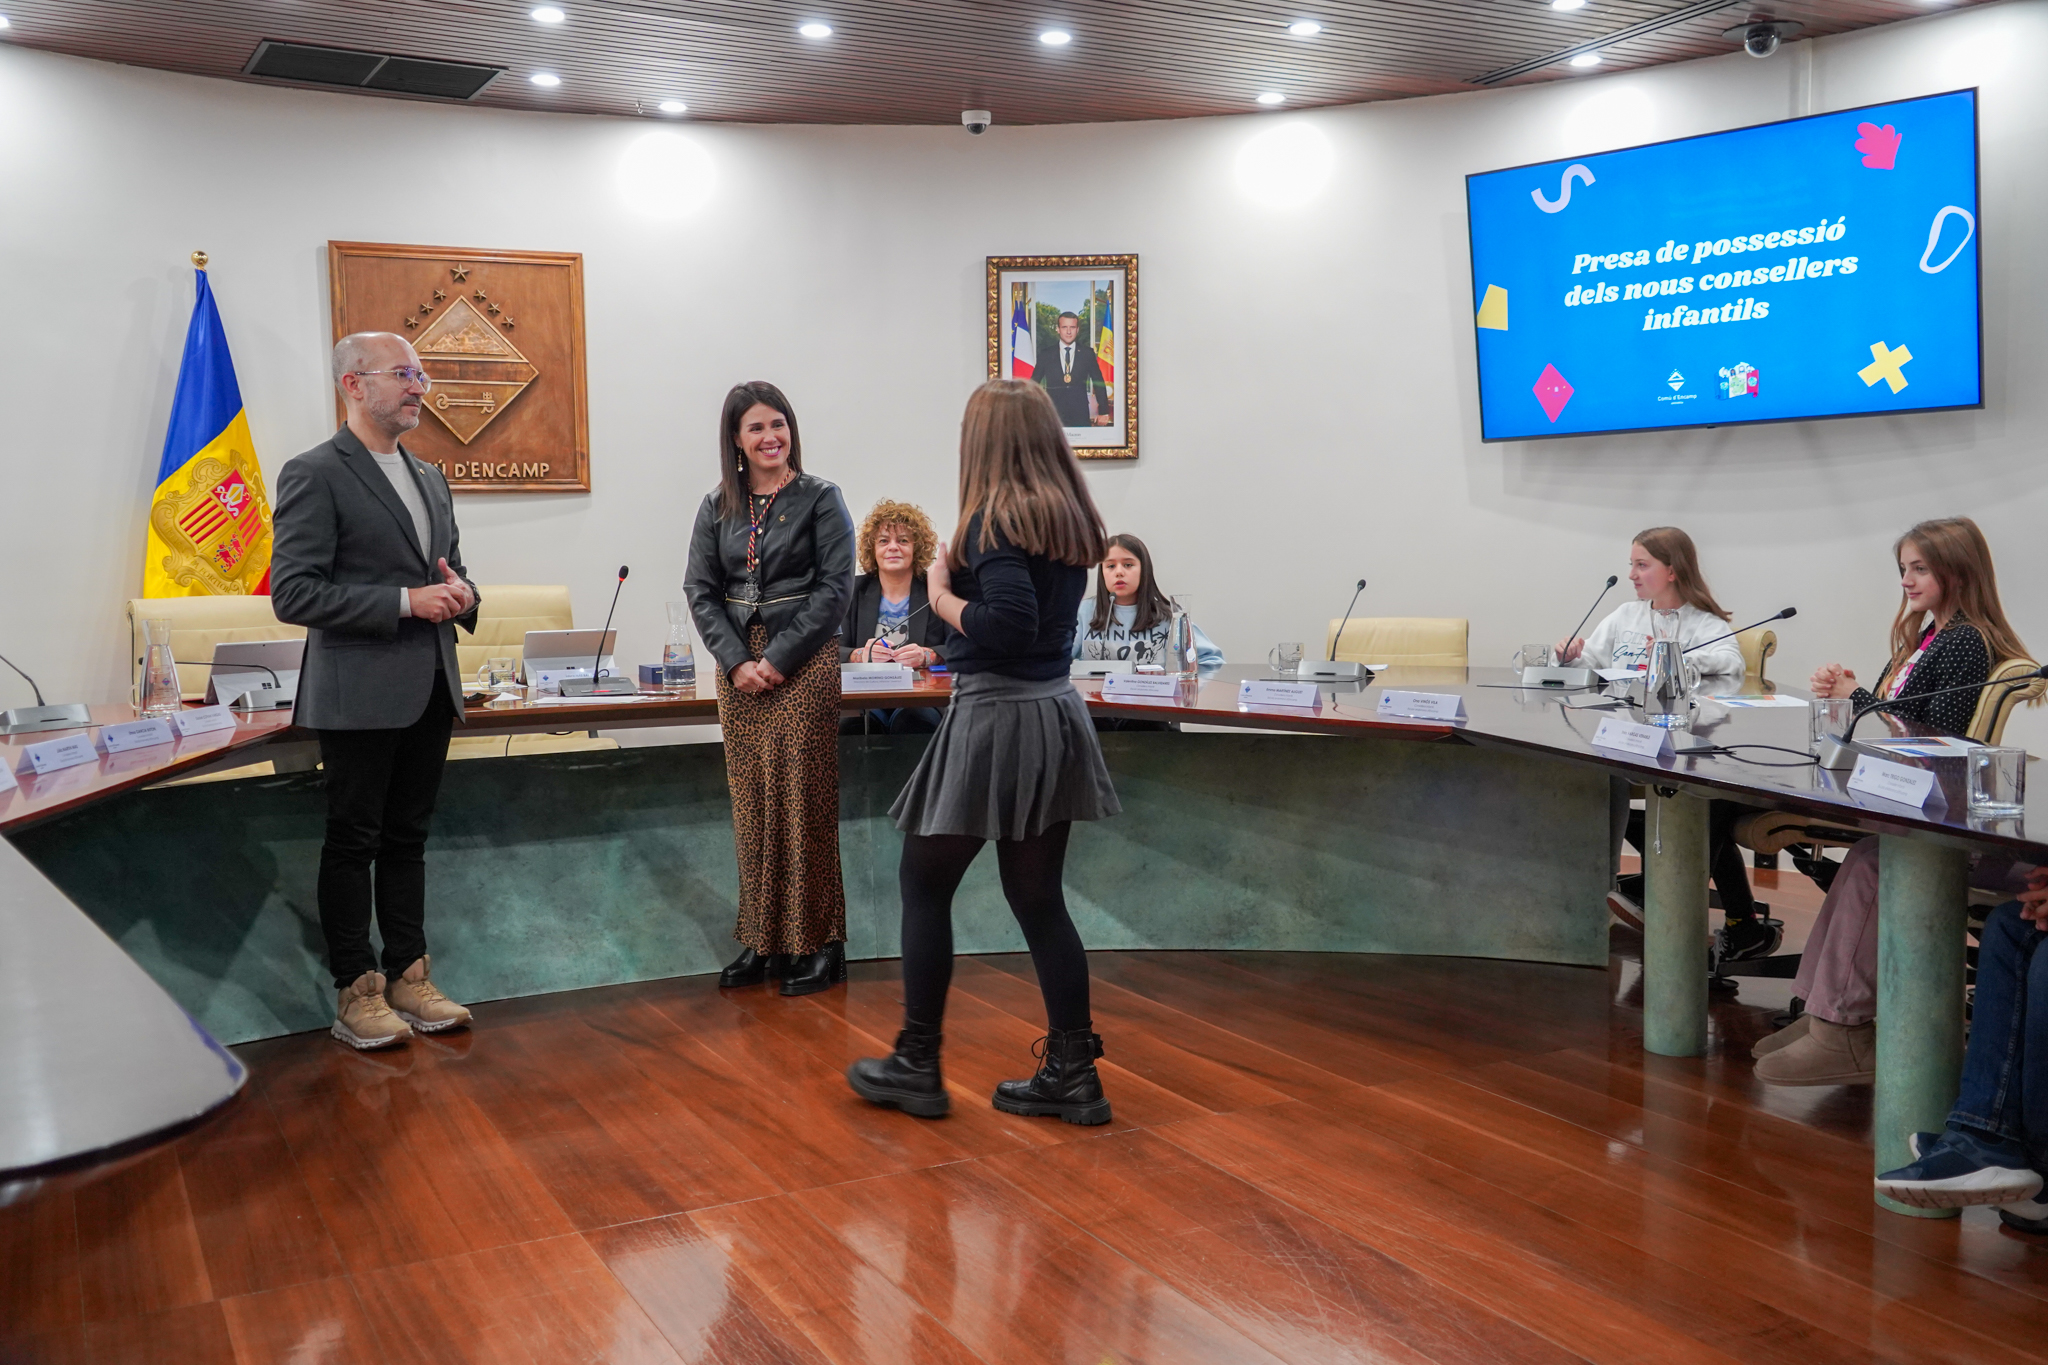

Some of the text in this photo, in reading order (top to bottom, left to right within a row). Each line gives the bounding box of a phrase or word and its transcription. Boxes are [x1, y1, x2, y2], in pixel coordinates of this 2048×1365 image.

[1571, 215, 1846, 275] Presa de possessió
[1564, 256, 1859, 307] dels nous consellers
[1642, 297, 1770, 331] infantils
[454, 460, 550, 479] D'ENCAMP
